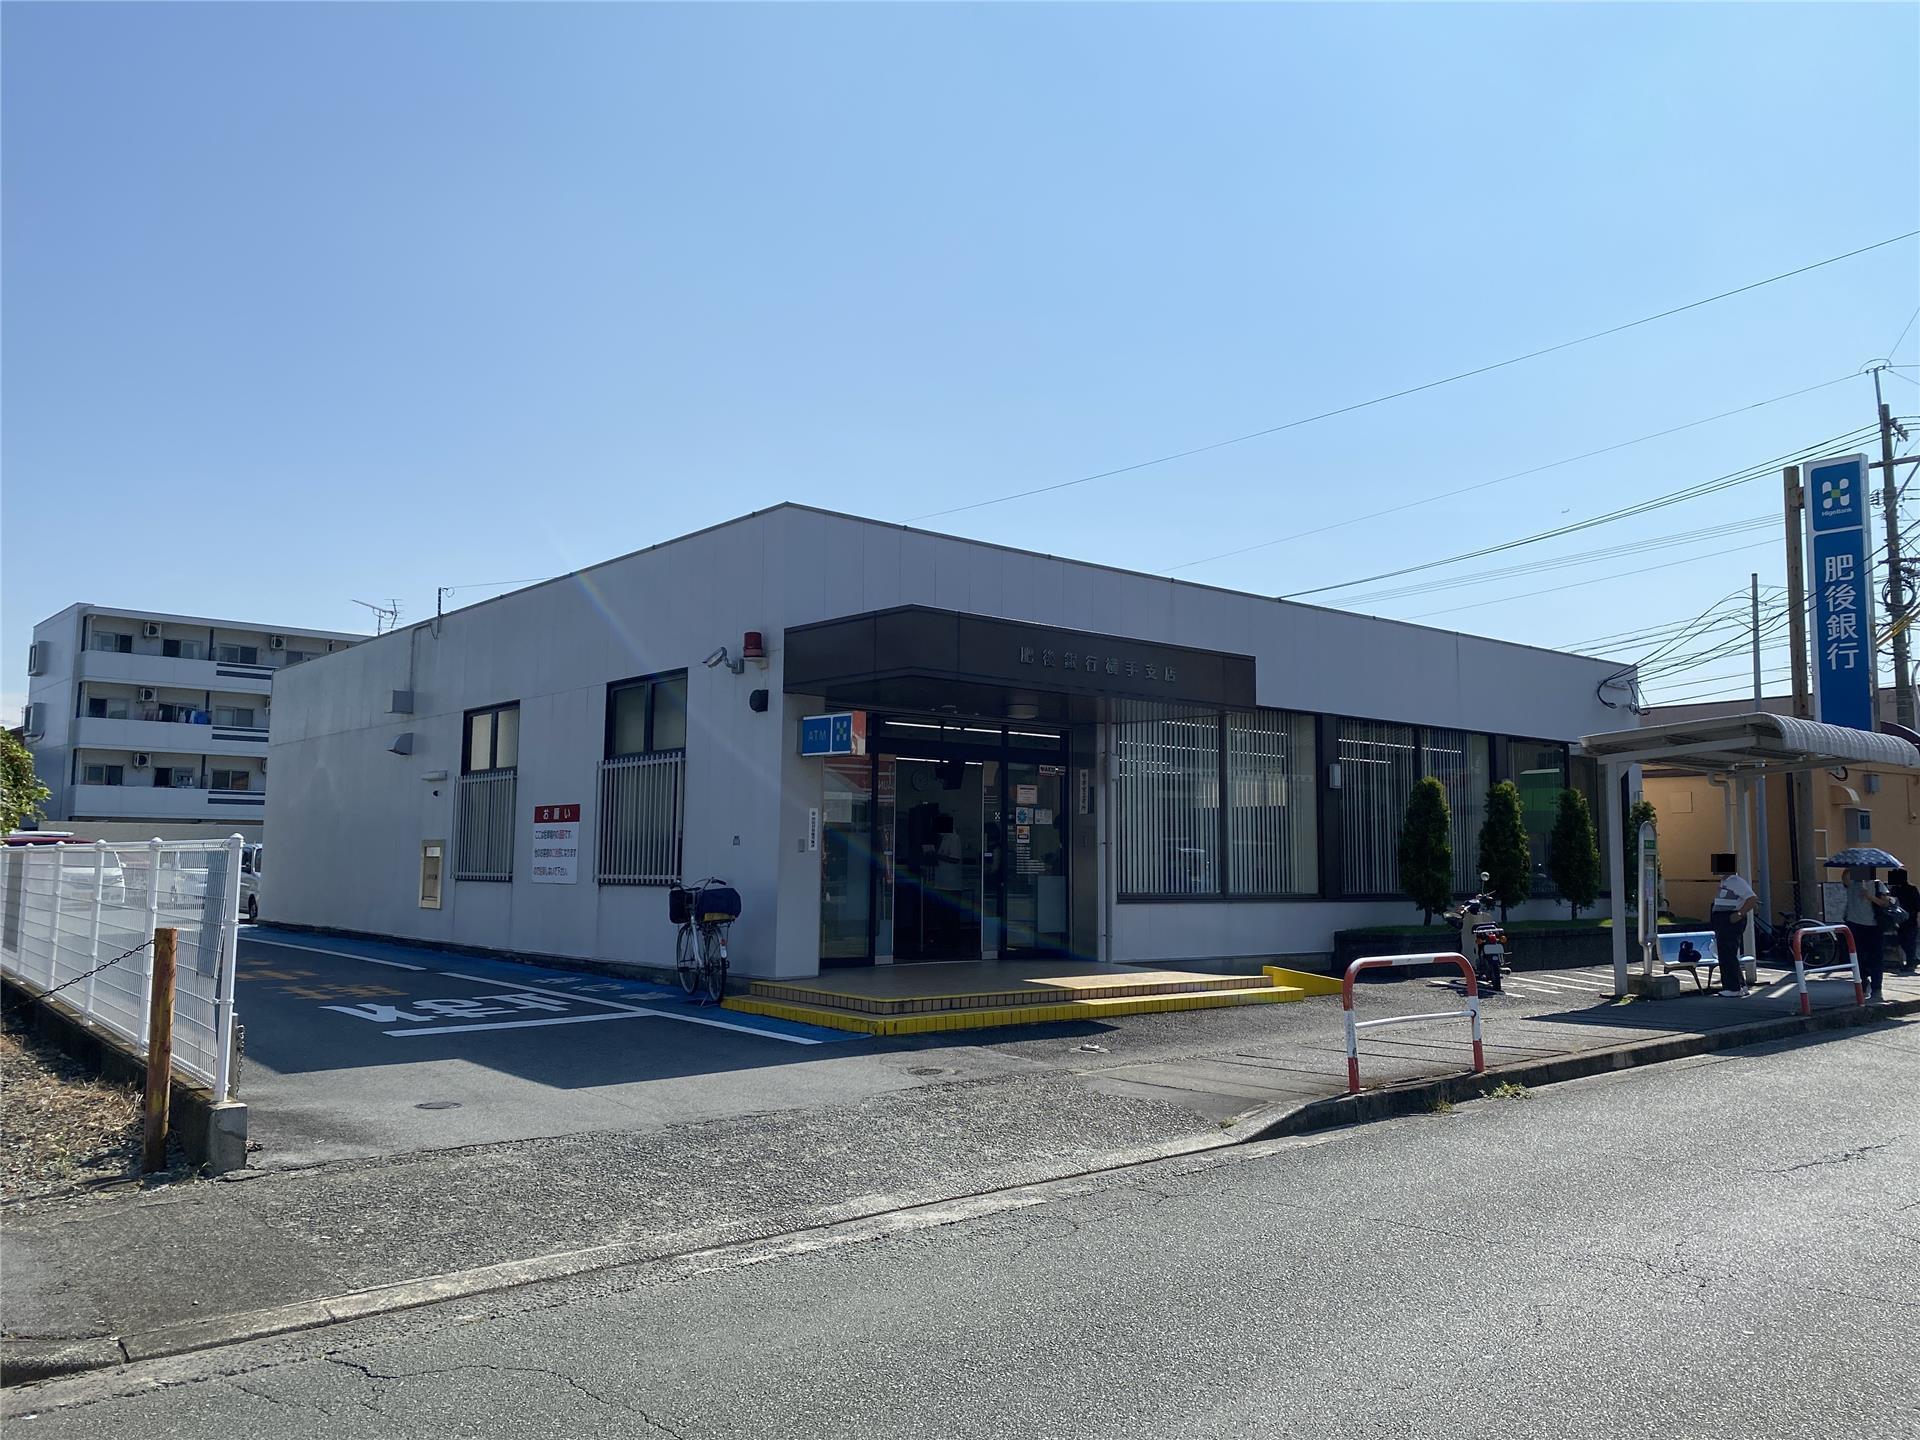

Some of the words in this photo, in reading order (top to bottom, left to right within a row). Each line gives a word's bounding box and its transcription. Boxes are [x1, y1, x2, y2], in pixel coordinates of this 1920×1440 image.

[1824, 554, 1859, 671] 肥後銀行
[1020, 646, 1177, 683] 肥後銀行横手支店
[807, 728, 827, 743] ATM
[318, 992, 572, 1023] 止まれ
